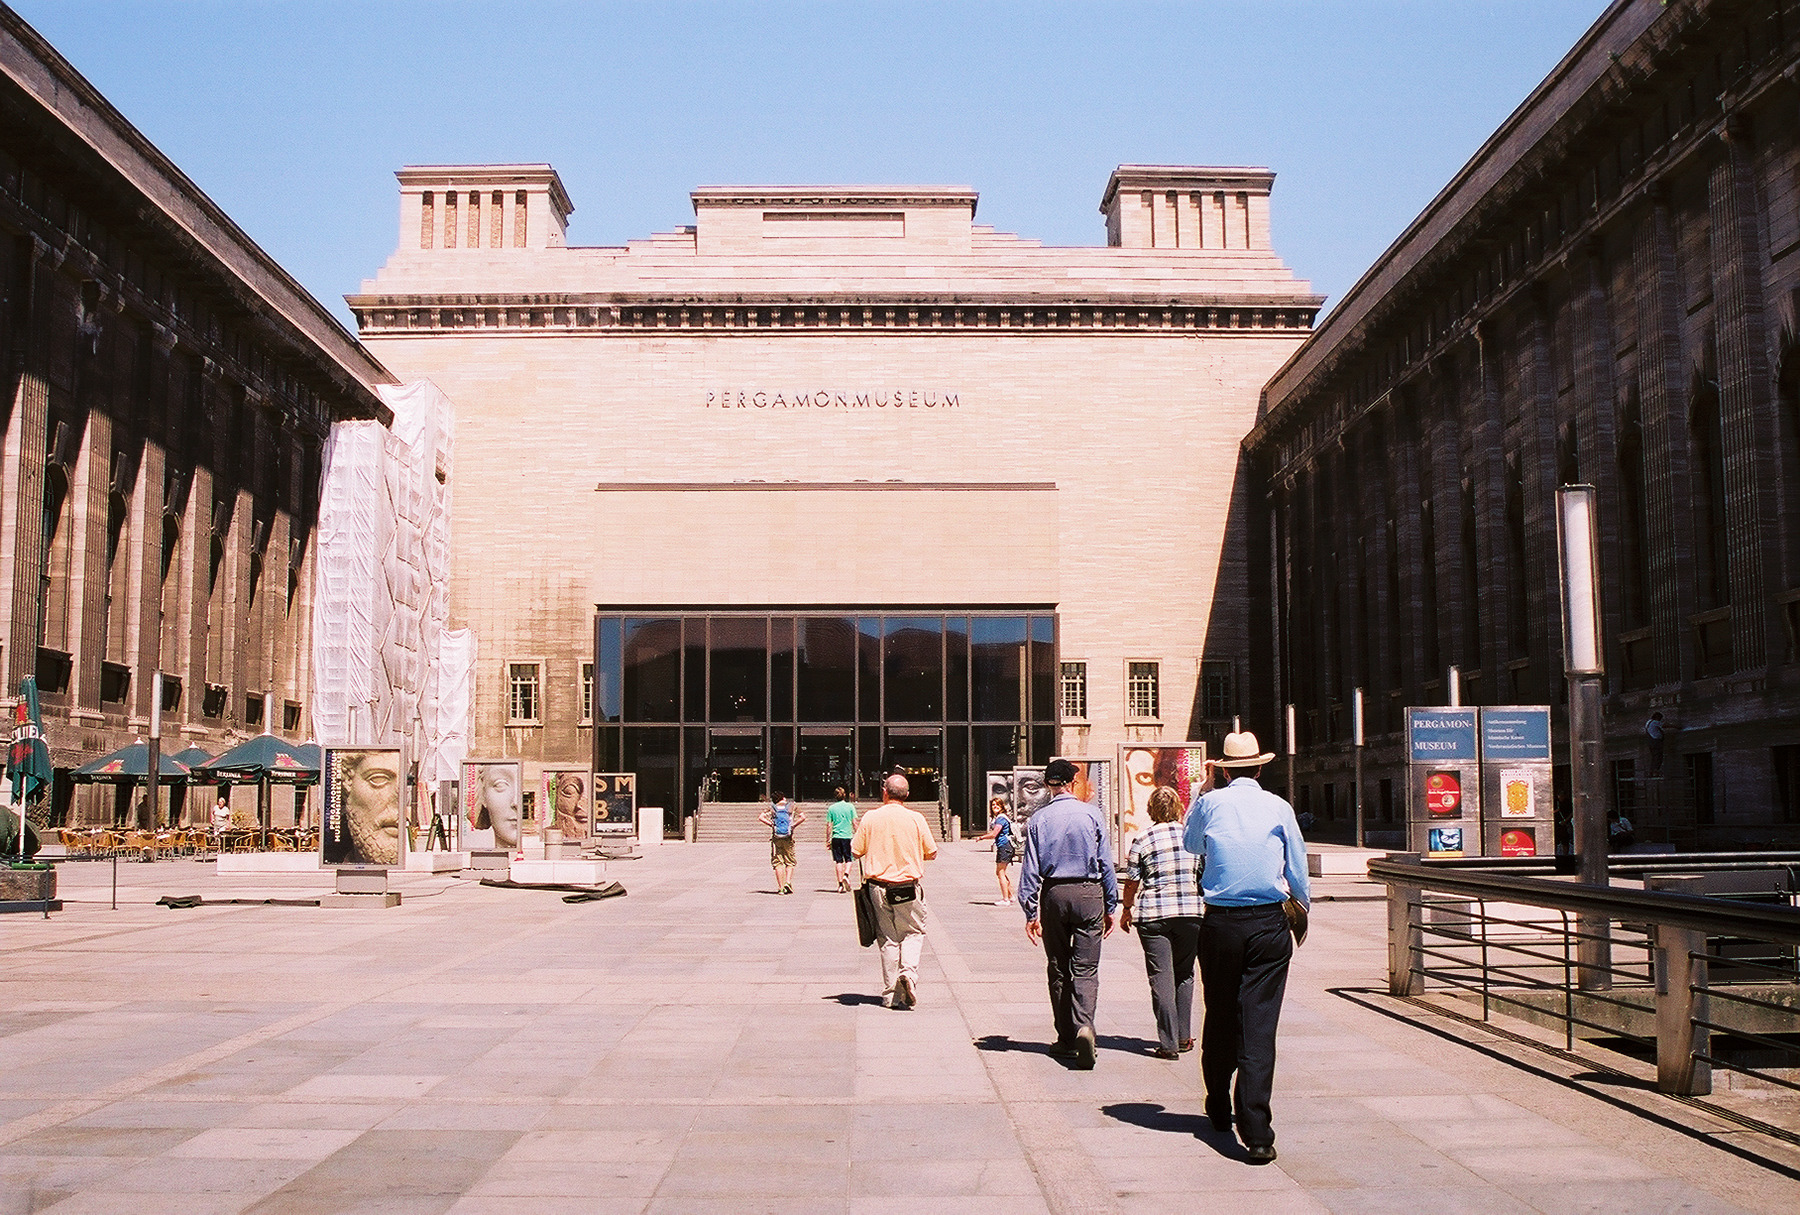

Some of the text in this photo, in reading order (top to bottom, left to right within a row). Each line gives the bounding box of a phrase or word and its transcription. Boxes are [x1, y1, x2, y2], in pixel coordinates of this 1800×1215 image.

[706, 390, 960, 408] PERGAMONMUSEUM
[1413, 719, 1473, 730] PERGAMON-
[1414, 741, 1457, 751] MUSEUM
[595, 776, 633, 793] S M
[595, 799, 609, 820] B
